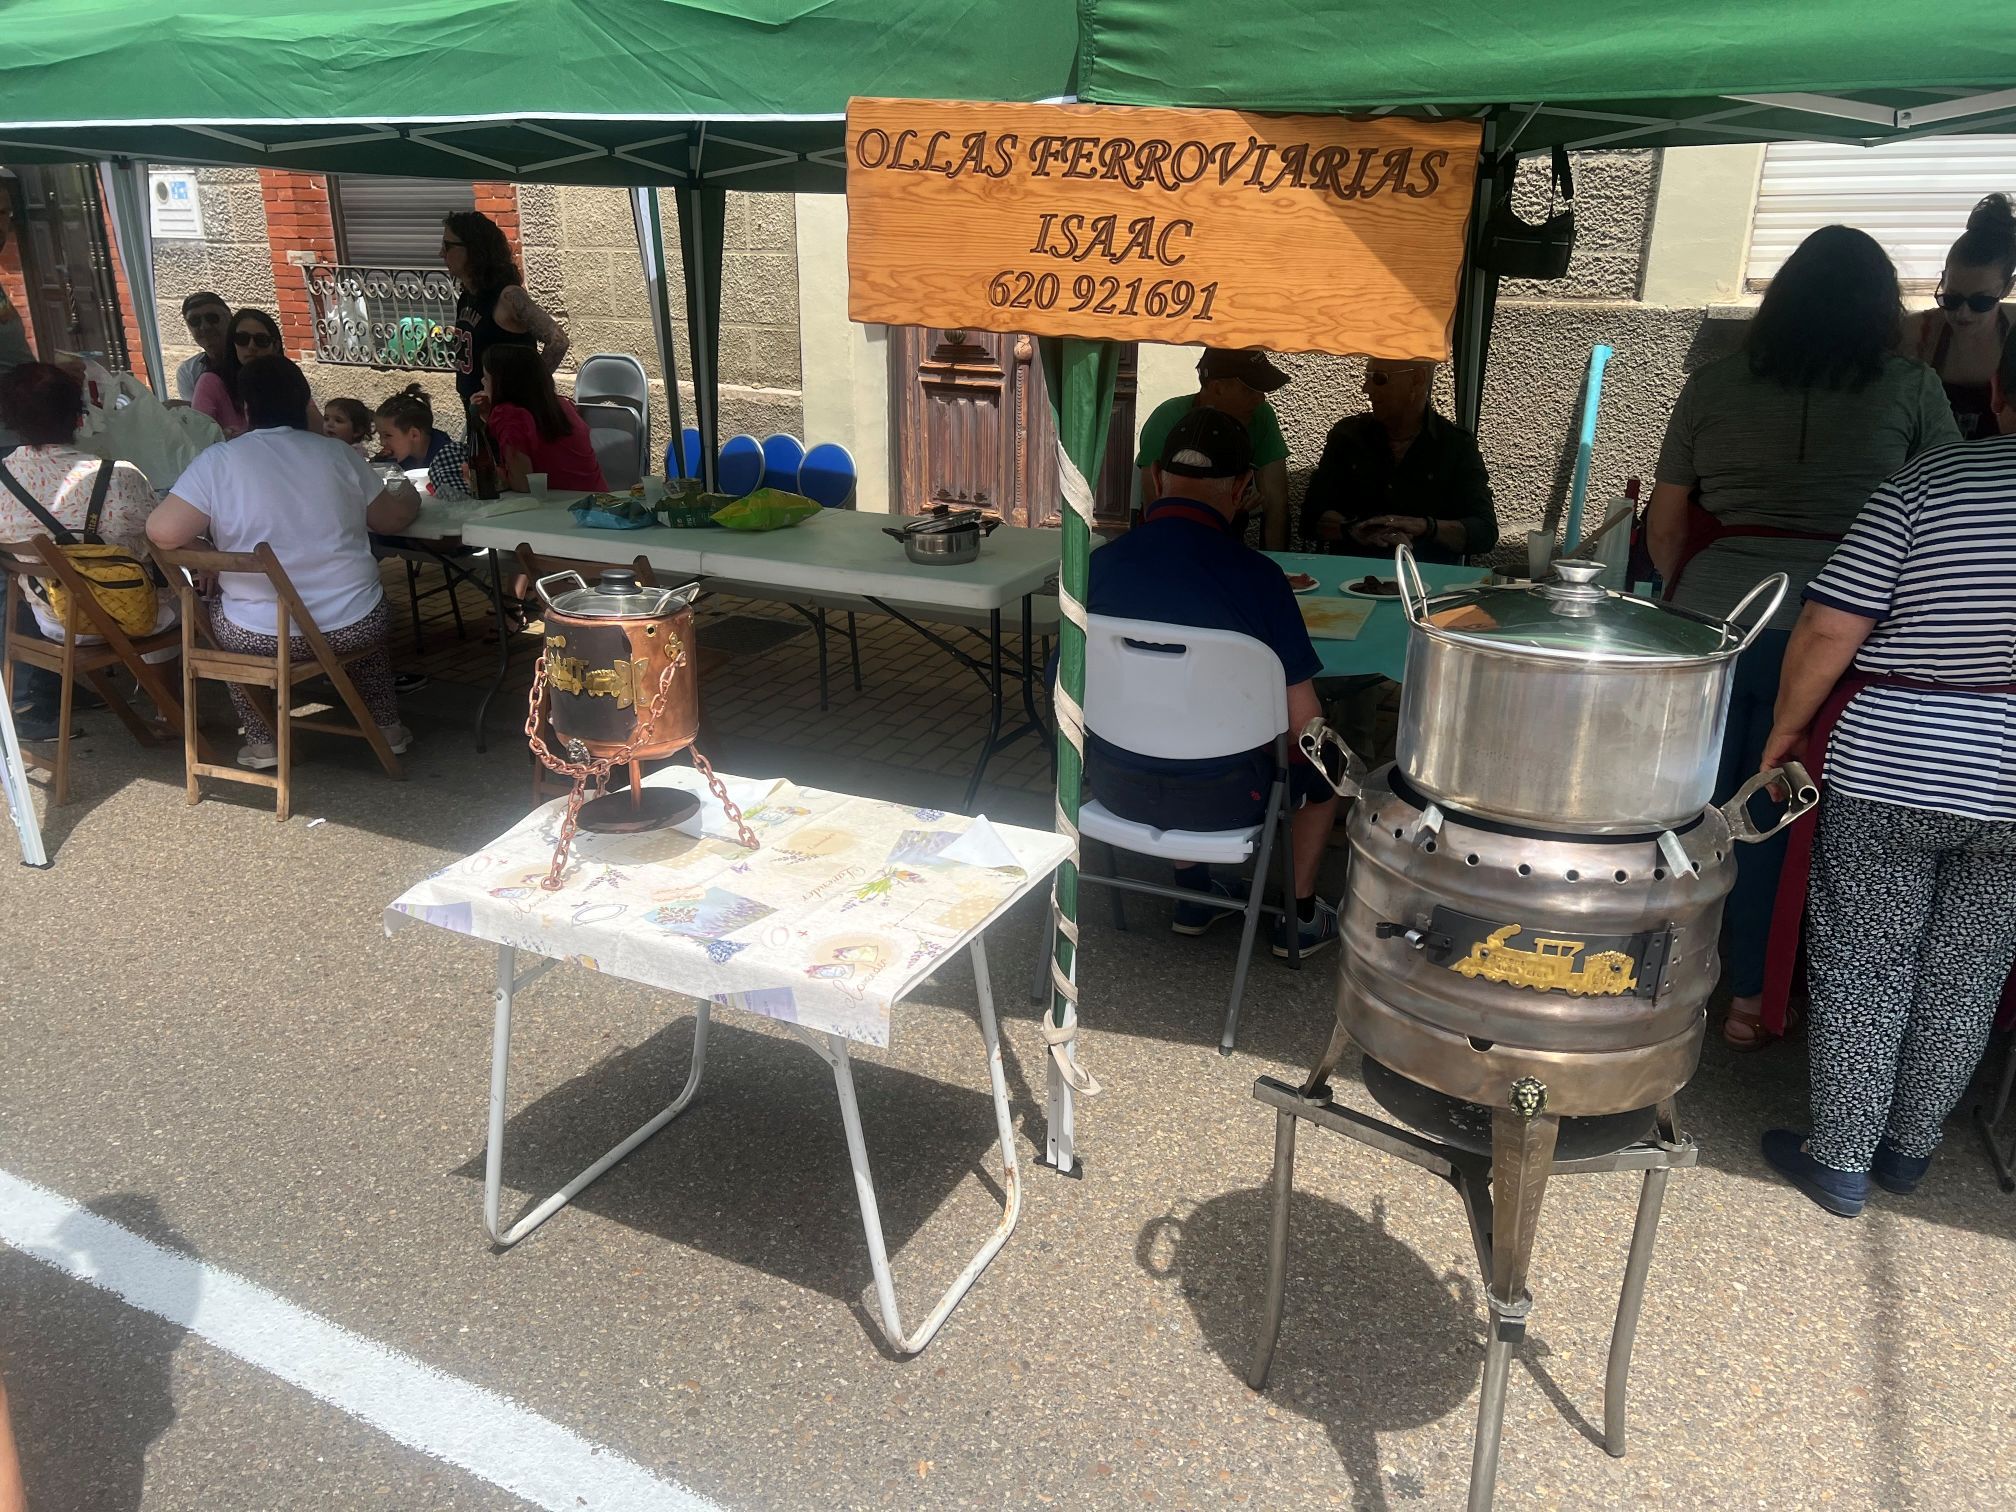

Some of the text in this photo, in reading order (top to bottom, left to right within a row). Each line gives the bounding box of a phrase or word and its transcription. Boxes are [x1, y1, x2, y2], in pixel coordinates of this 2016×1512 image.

[856, 128, 1449, 199] OLLAS FERROVIARIAS
[1030, 213, 1194, 266] ISAAC
[988, 270, 1219, 321] 620 921691
